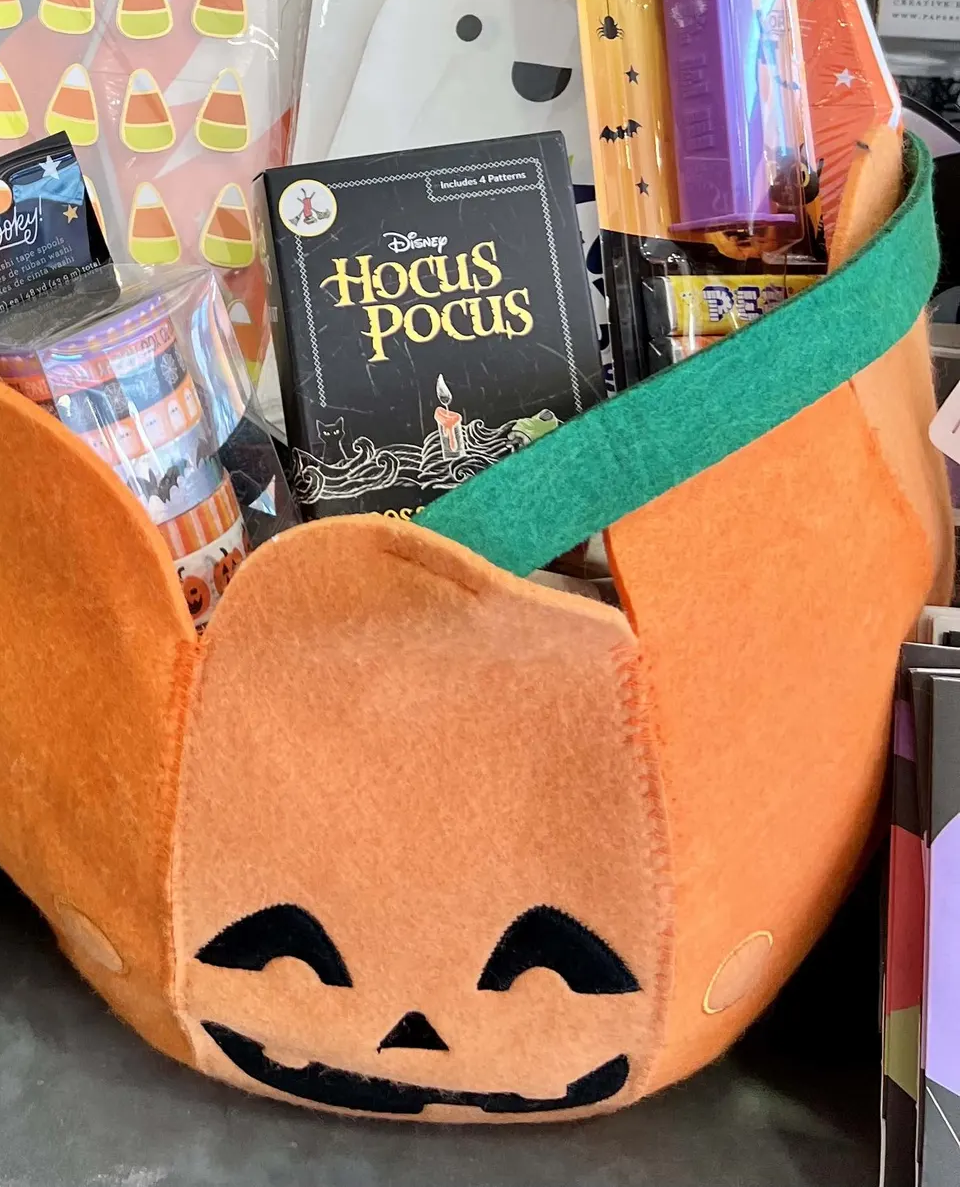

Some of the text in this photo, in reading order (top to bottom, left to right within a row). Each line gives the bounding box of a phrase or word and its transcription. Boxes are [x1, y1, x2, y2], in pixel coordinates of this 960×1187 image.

[440, 171, 527, 190] Includes 4 Patterns
[9, 267, 19, 280] de
[21, 257, 47, 274] ruban
[48, 245, 73, 264] washi
[15, 250, 35, 269] tape
[37, 237, 65, 257] spools
[15, 276, 25, 288] de
[26, 266, 49, 283] cinta
[51, 256, 75, 272] washi
[25, 288, 36, 302] 48
[37, 281, 48, 297] yd
[81, 258, 101, 275] total
[319, 240, 504, 308] HOCUS
[360, 288, 534, 363] POCUS
